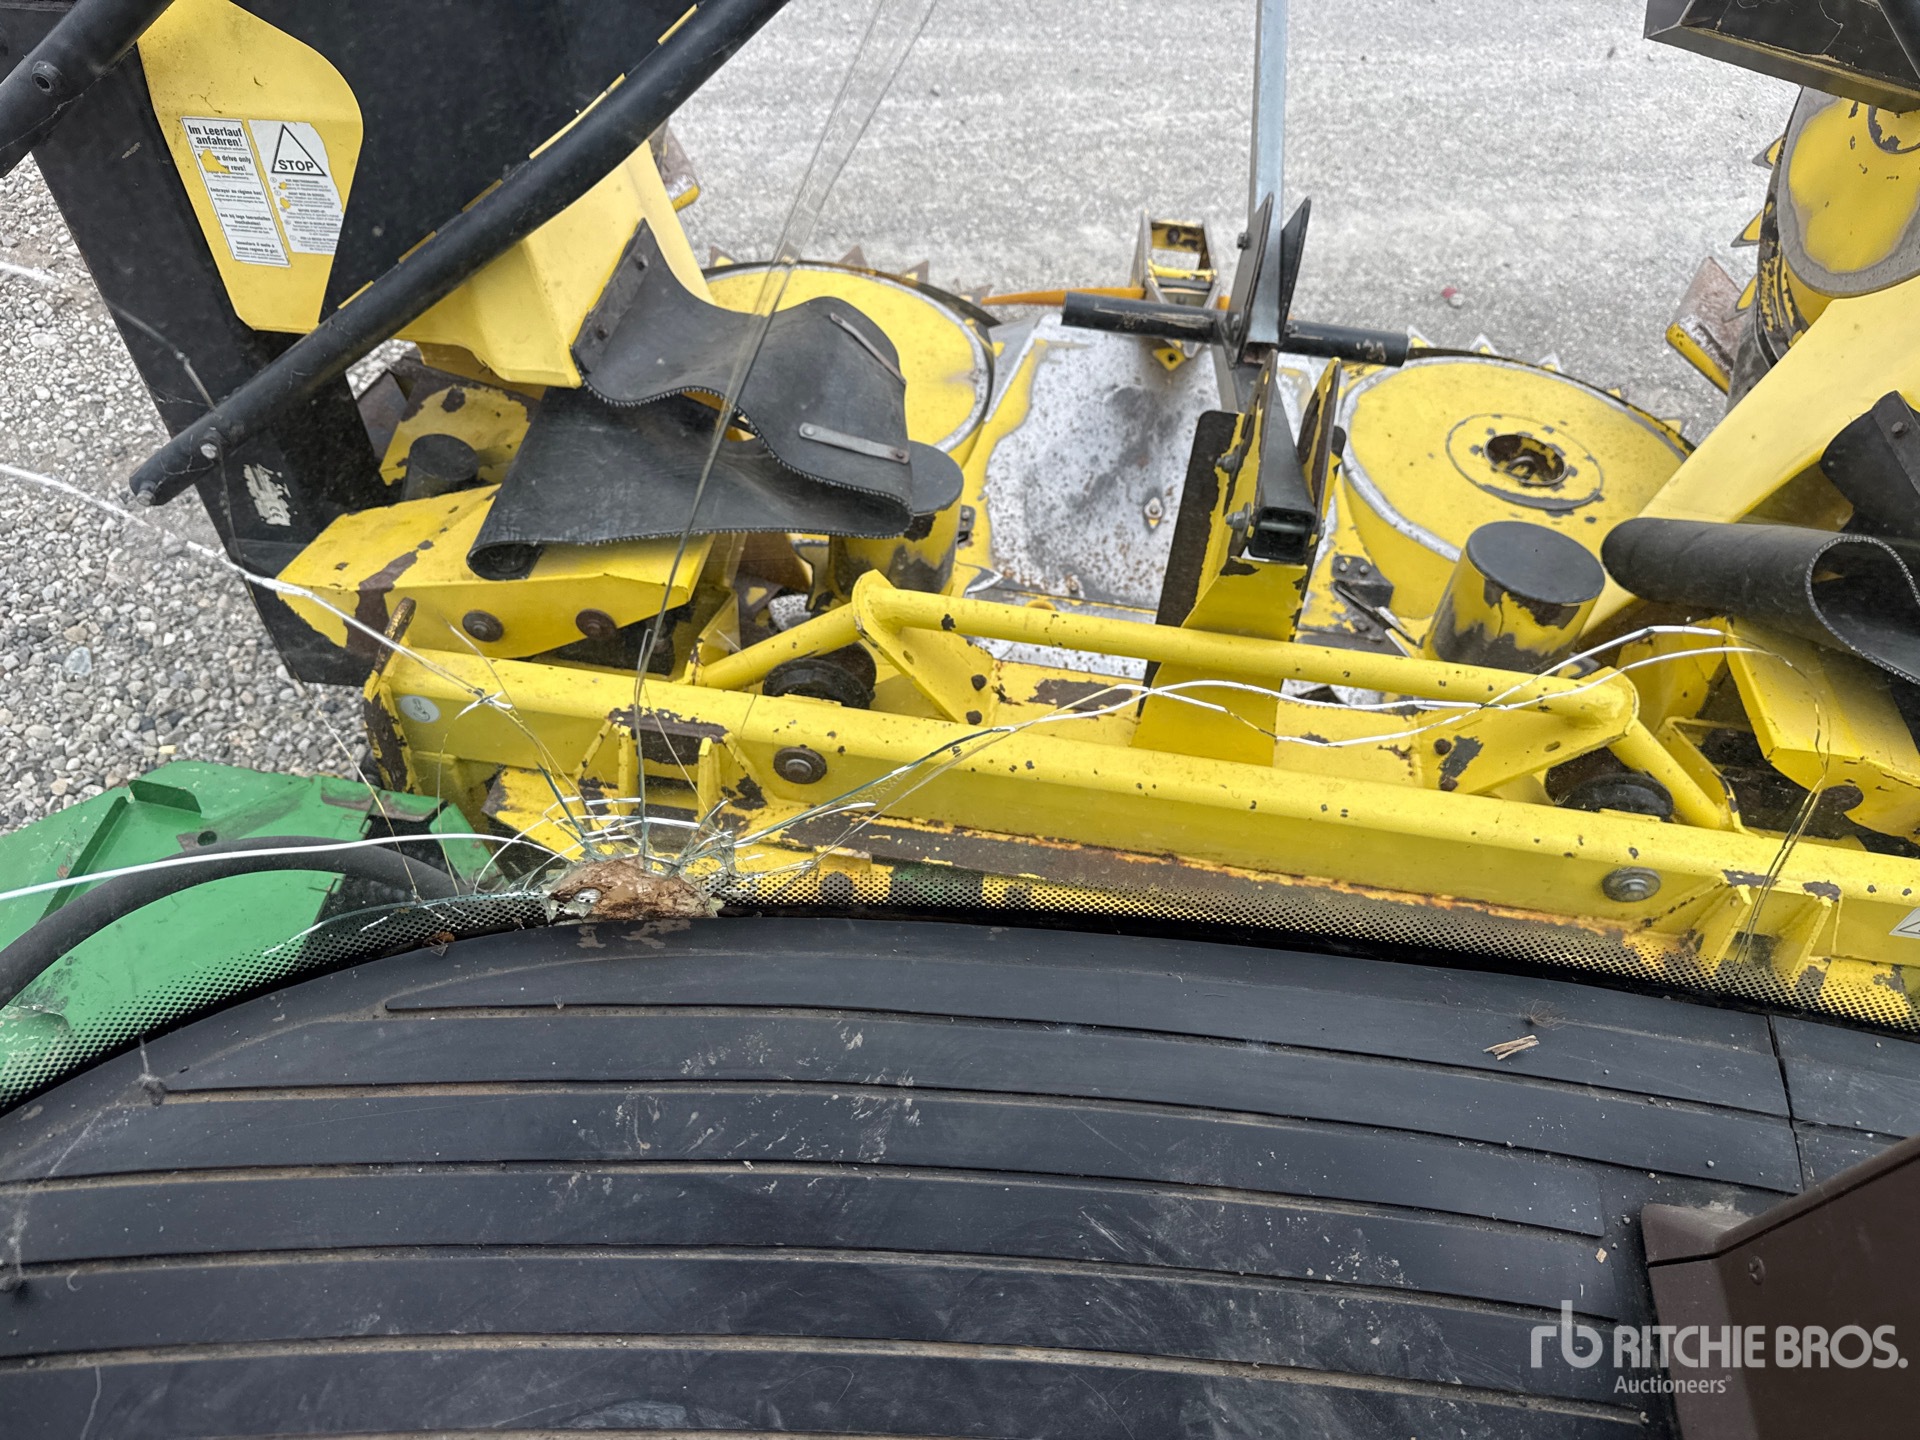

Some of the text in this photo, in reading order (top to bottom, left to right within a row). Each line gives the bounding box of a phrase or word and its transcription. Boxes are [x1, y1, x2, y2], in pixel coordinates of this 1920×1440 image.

[188, 125, 243, 137] Im Leerlauf
[196, 136, 243, 147] anfahren!
[222, 155, 238, 163] drive
[239, 156, 251, 164] only
[278, 159, 314, 172] STOP
